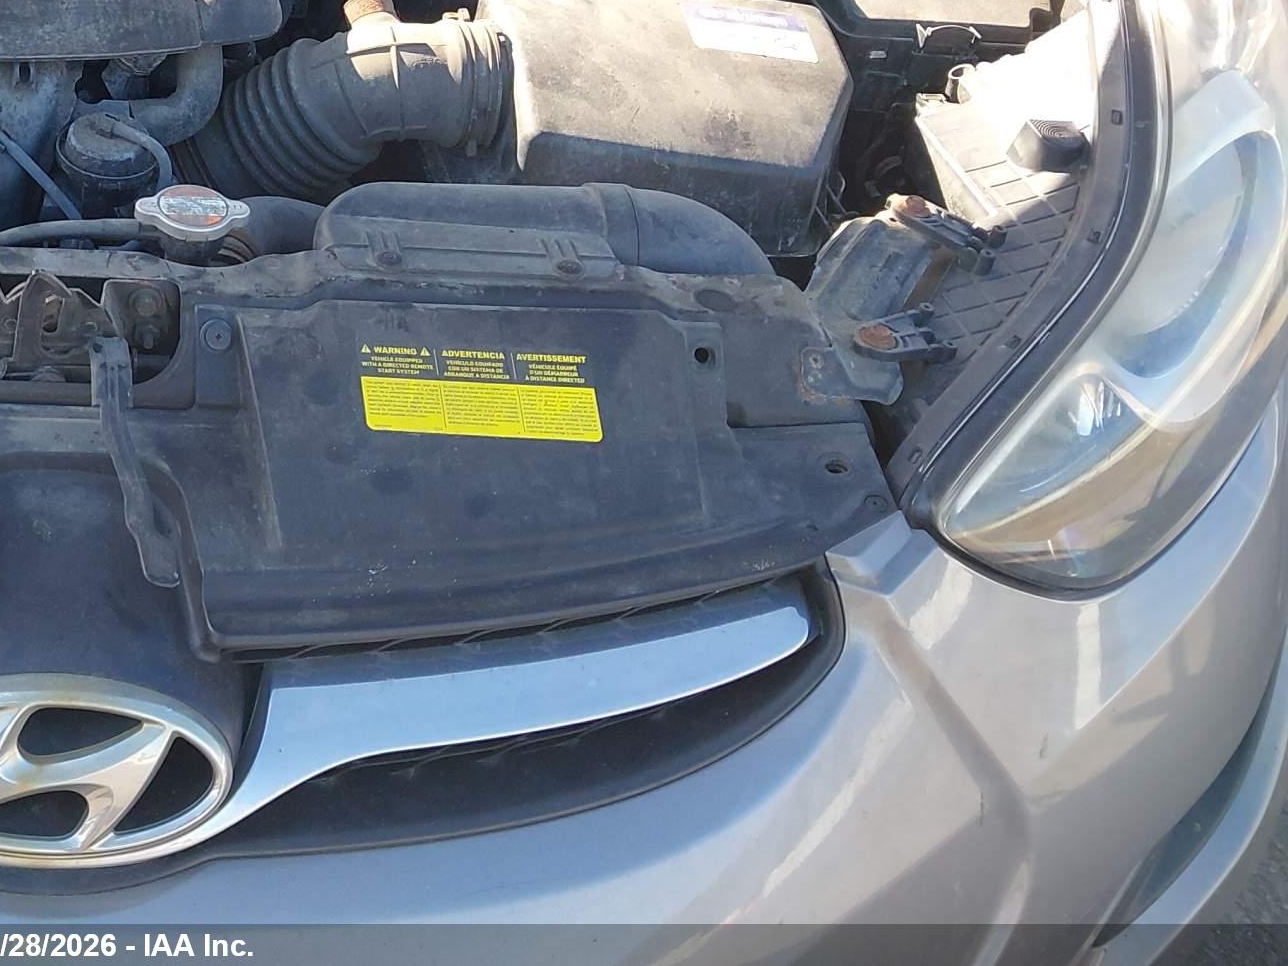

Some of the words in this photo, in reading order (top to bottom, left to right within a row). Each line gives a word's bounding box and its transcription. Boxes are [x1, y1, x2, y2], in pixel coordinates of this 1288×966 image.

[373, 346, 417, 356] WARNING
[441, 350, 505, 360] ADVERTENCIA
[516, 353, 586, 364] AVERTISSEMENT
